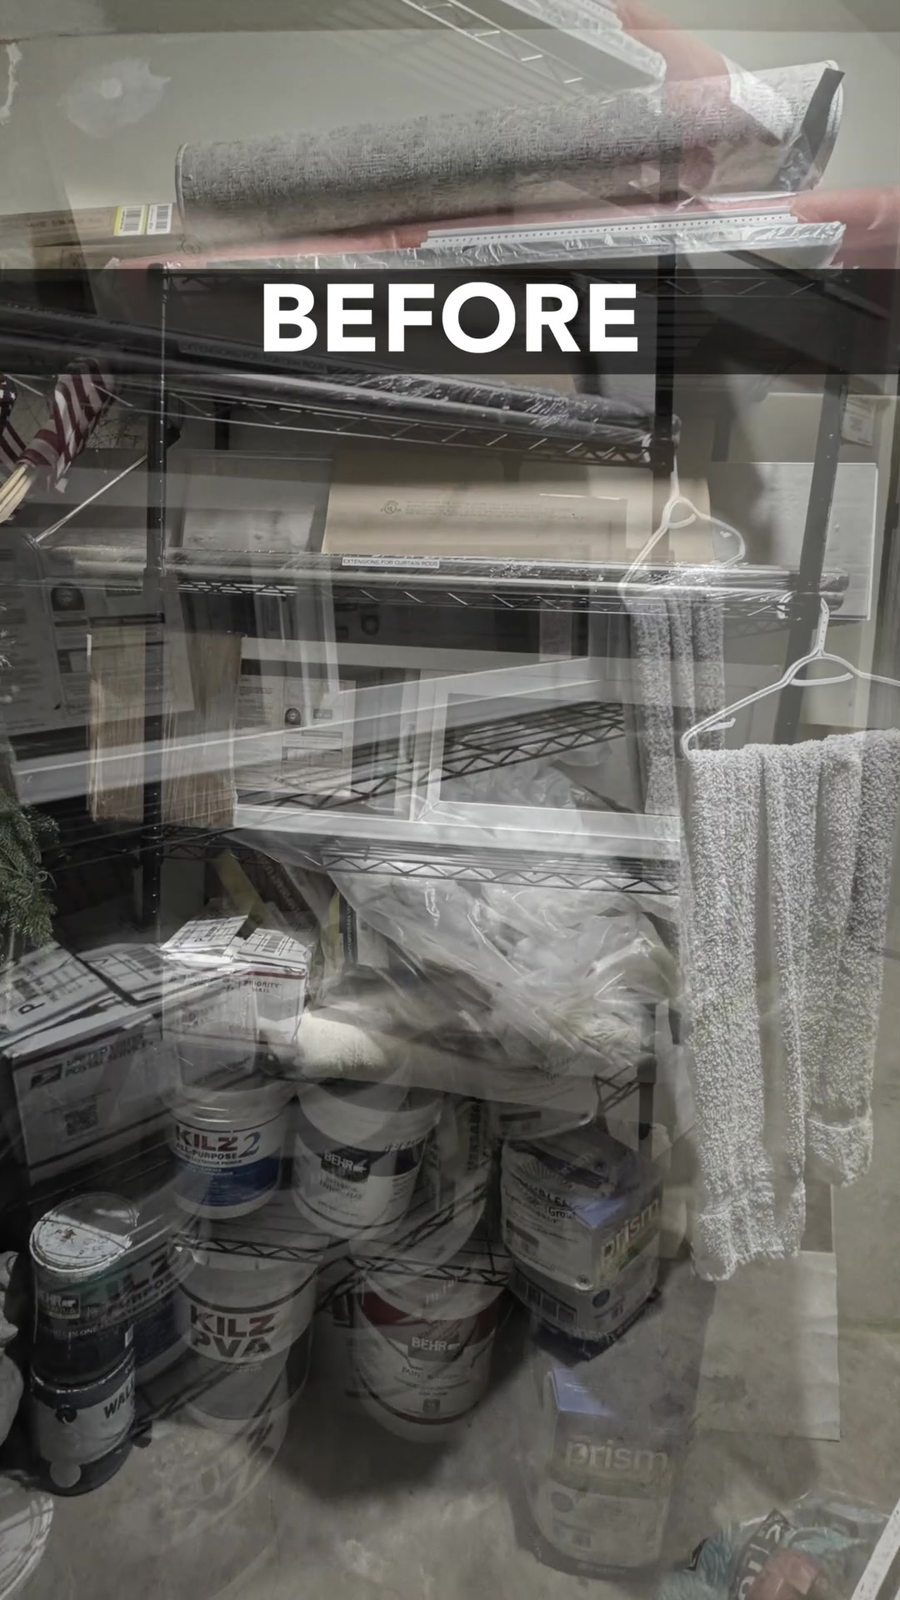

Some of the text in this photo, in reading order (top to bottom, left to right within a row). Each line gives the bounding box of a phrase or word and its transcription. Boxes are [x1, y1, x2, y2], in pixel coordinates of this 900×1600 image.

[343, 558, 439, 568] EXTENSIONS FOR CURTAIN RODS
[176, 1124, 262, 1159] KILZ 2
[324, 1151, 354, 1171] BEHR
[601, 1198, 662, 1264] prism
[190, 1304, 277, 1338] KILZ
[191, 1329, 272, 1358] PVA
[411, 1335, 449, 1352] BEHR
[564, 1438, 669, 1470] prism
